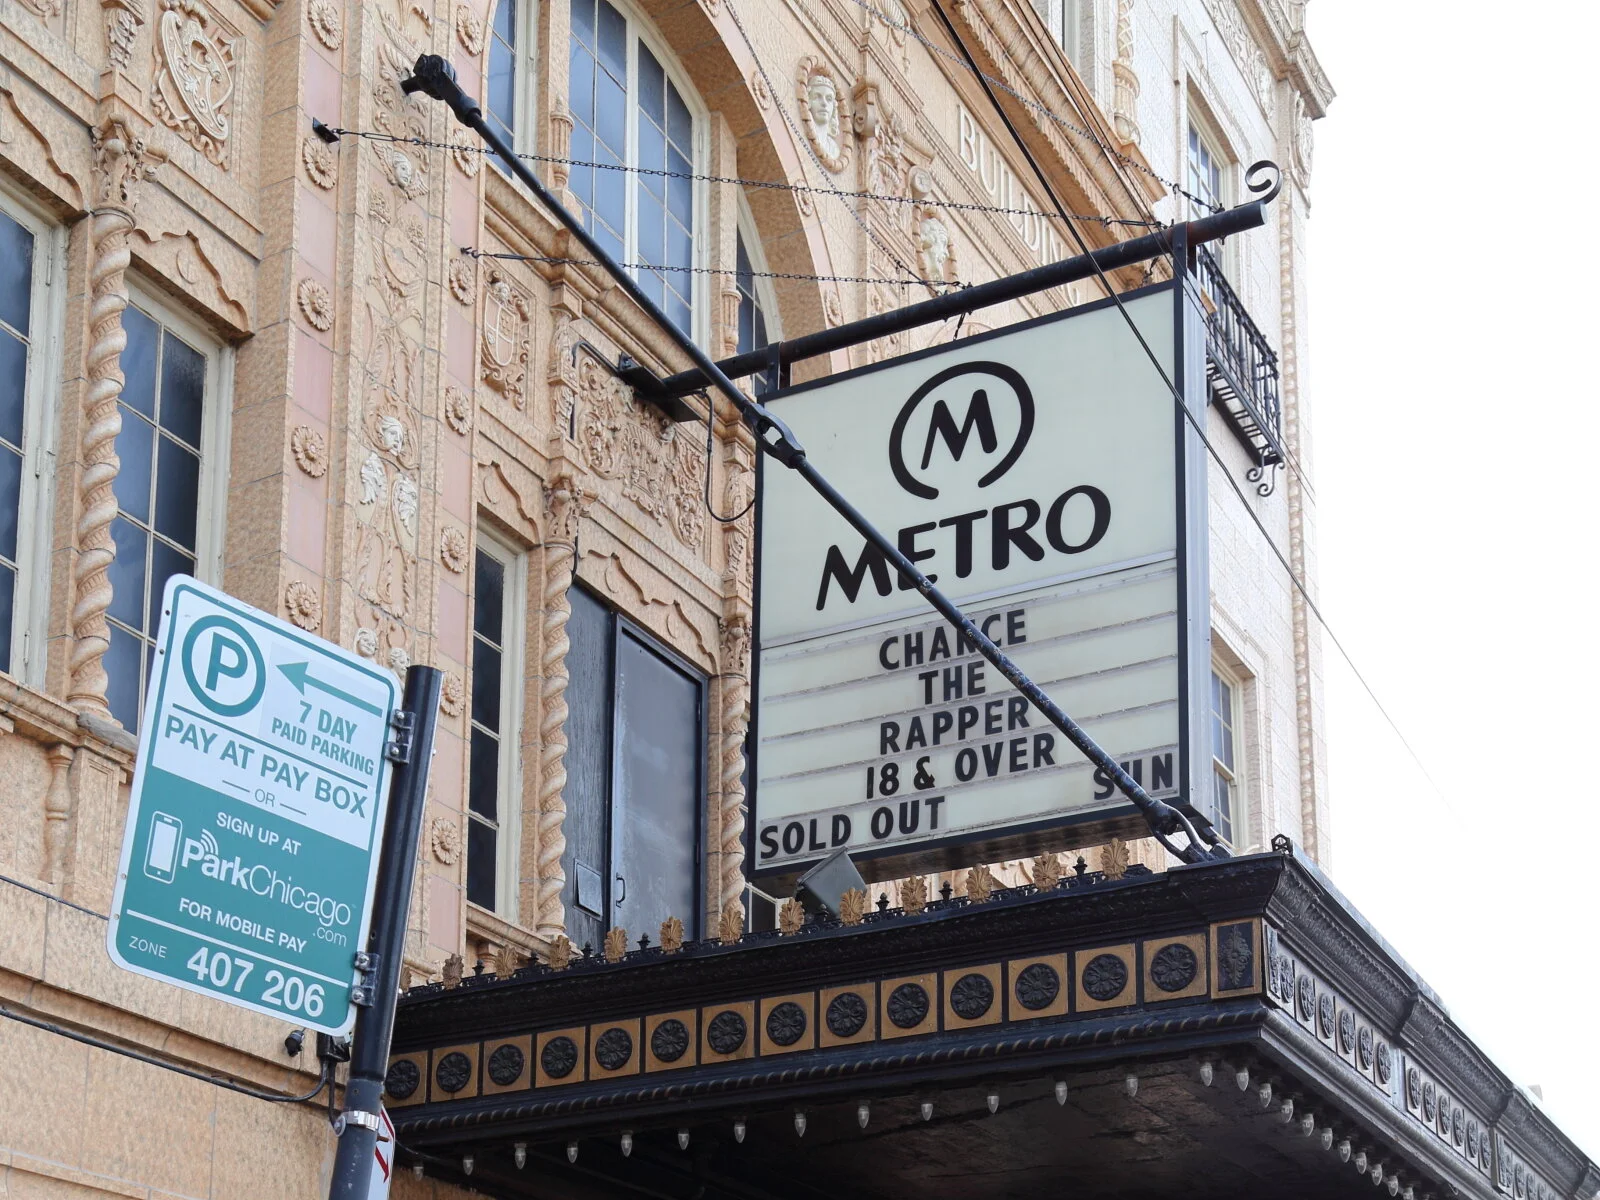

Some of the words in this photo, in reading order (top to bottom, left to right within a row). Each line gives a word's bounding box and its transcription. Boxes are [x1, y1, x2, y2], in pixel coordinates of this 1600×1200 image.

[816, 485, 1111, 611] METRO
[205, 631, 248, 691] P
[879, 608, 1026, 671] CHANCE
[918, 661, 986, 704] THE
[271, 717, 308, 746] PAID
[311, 735, 374, 776] PARKING
[299, 700, 312, 724] 7
[317, 709, 358, 745] DAY
[880, 696, 1029, 755] RAPPER
[164, 714, 218, 754] PAY
[219, 740, 255, 770] AT
[260, 754, 309, 792] PAY
[314, 777, 368, 819] BOX
[866, 762, 899, 800] 18
[913, 756, 936, 790] &
[955, 732, 1056, 782] OVER
[254, 788, 276, 808] OR
[759, 814, 851, 859] SOLD
[870, 796, 945, 840] OUT
[216, 811, 254, 838] SIGN
[257, 827, 280, 845] UP
[281, 837, 302, 856] AT
[128, 936, 168, 958] ZONE
[179, 897, 213, 922] FOR
[215, 910, 276, 944] MOBILE
[278, 932, 307, 953] PAY
[312, 927, 347, 947] .com
[186, 946, 254, 993] 407
[261, 969, 325, 1018] 206
